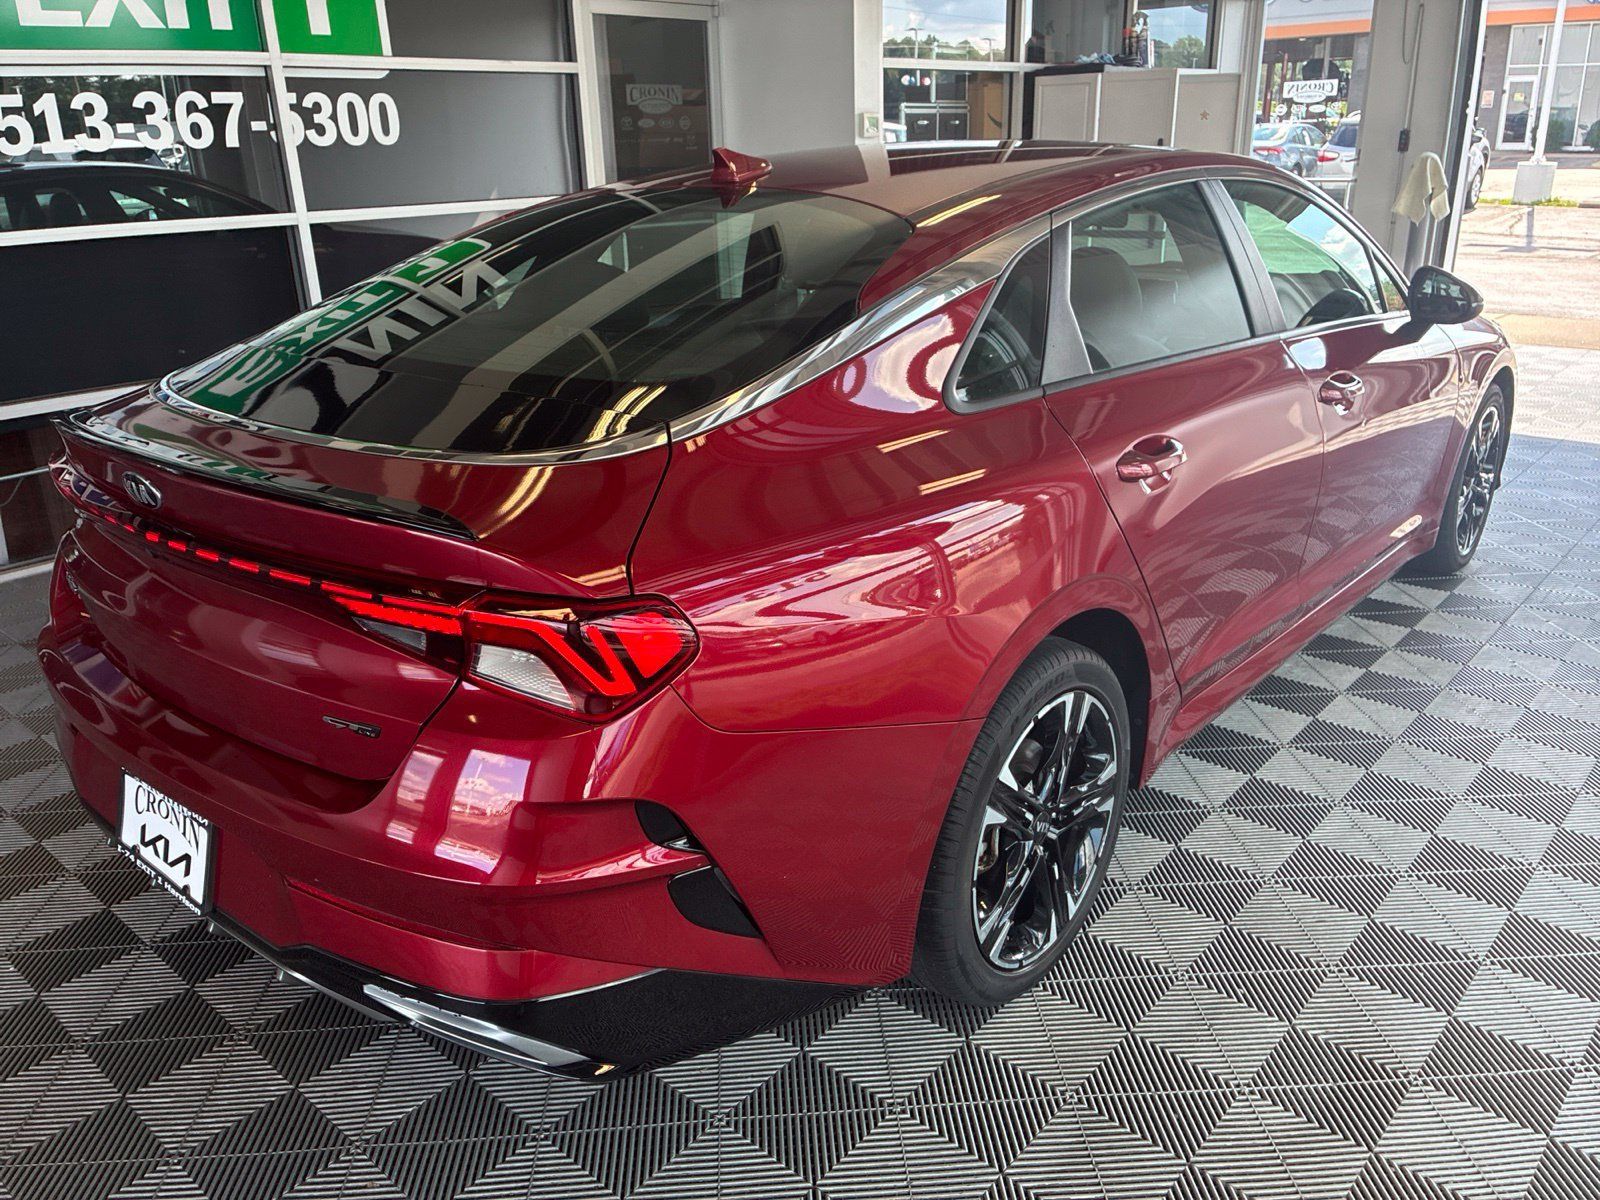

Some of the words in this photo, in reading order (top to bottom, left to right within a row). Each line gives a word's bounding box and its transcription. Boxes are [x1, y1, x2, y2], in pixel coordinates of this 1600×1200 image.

[630, 86, 680, 103] CRONIN
[0, 91, 400, 156] 513-367-5300
[123, 477, 156, 506] KIA
[135, 785, 201, 856] CRONIN
[140, 823, 192, 878] KIA
[136, 859, 156, 877] EXIT
[164, 881, 201, 916] Harrison
